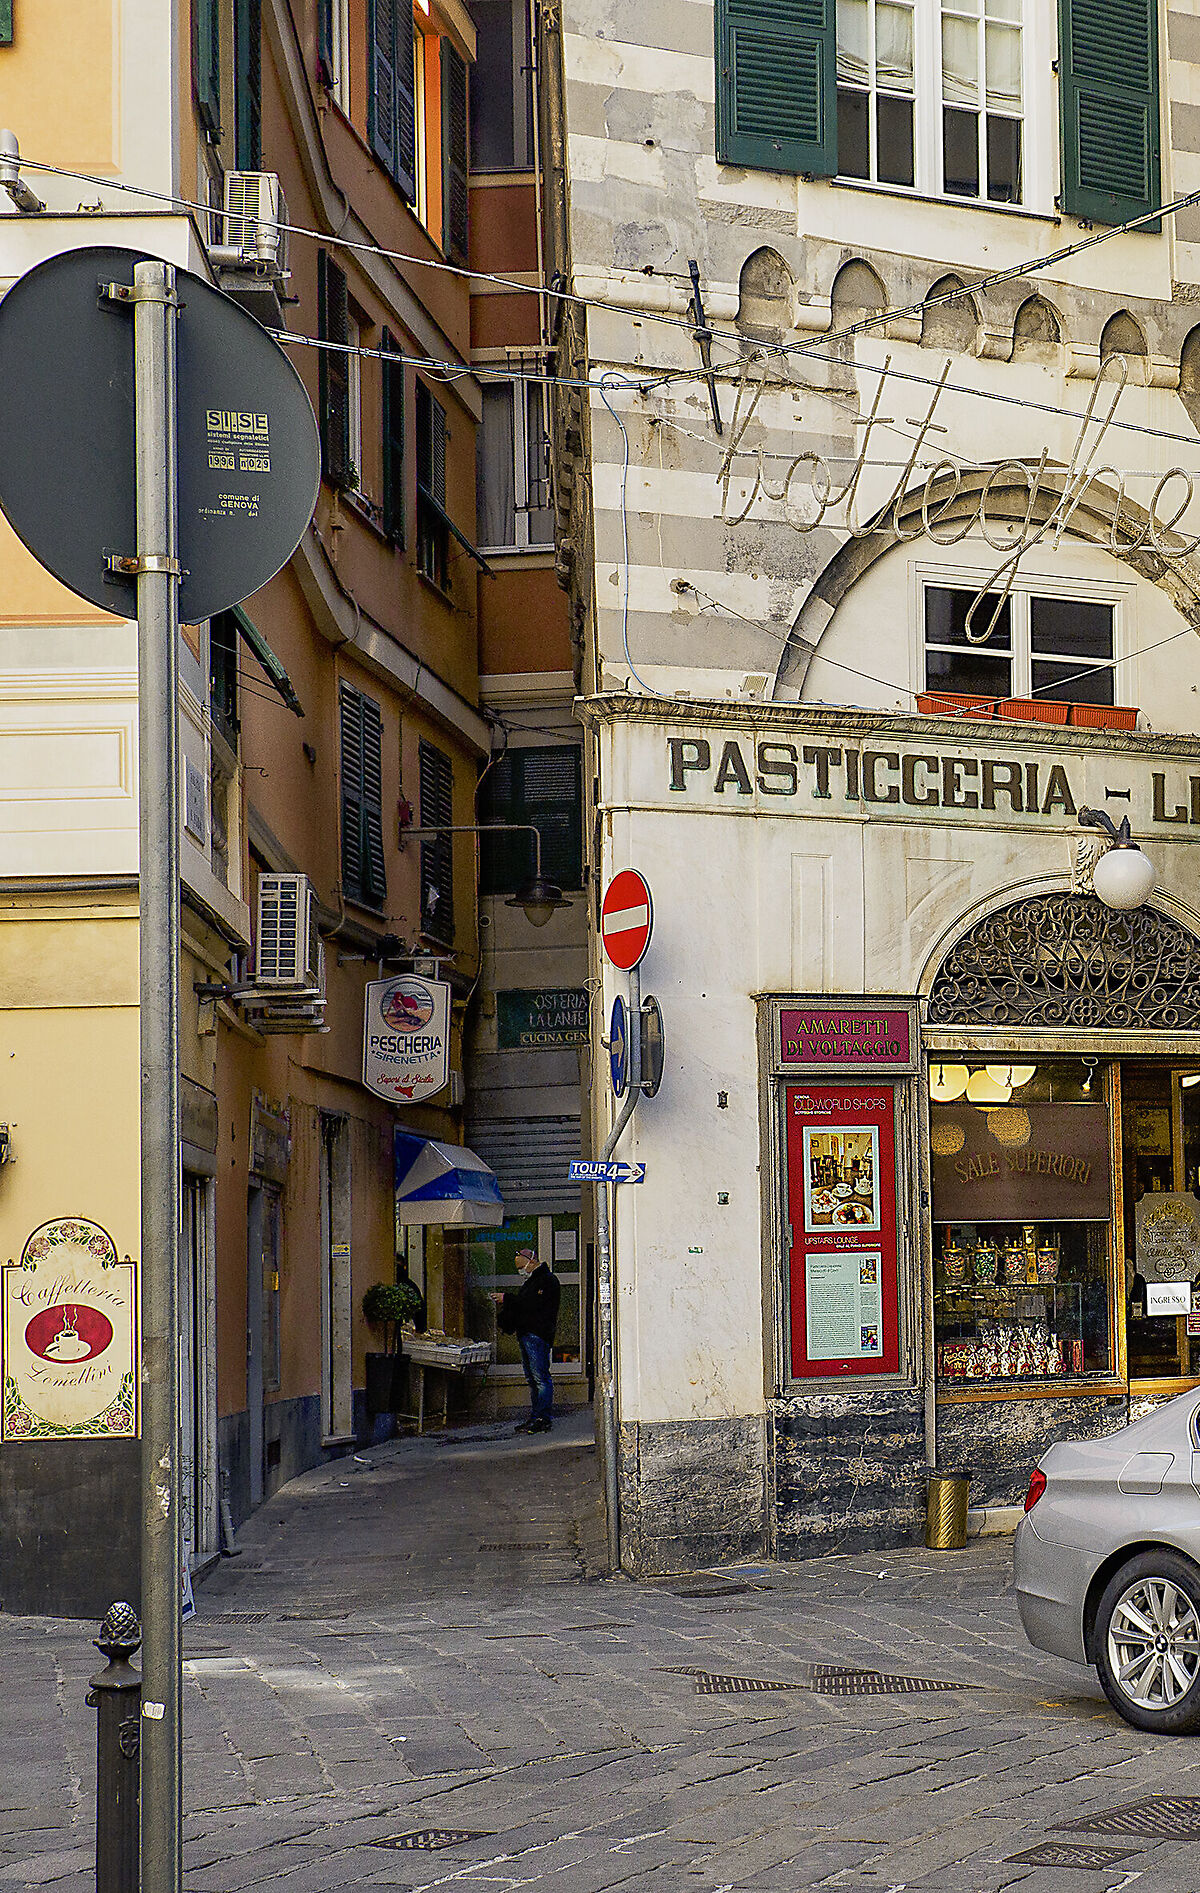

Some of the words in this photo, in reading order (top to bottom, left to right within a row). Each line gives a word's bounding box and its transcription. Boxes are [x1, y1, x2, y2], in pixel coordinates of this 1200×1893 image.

[207, 411, 268, 431] SI.SE
[207, 431, 231, 439] sistemi
[233, 434, 269, 442] segnaletici
[209, 456, 235, 467] 1996
[218, 493, 249, 501] comune
[220, 500, 258, 509] GENOVA
[667, 737, 1077, 816] PASTICCERIA
[534, 993, 587, 1009] OSTERIA
[547, 1011, 588, 1027] LANTE
[797, 1019, 888, 1035] AMARETTI
[370, 1035, 442, 1054] PESCHERIA
[522, 1032, 563, 1043] CUCINA
[787, 1040, 803, 1055] DI
[808, 1040, 901, 1056] VOLTAGGIO
[374, 1051, 438, 1065] SIRENETTA
[852, 1098, 886, 1111] SHOPS
[572, 1162, 607, 1175] TOUR
[606, 1164, 618, 1180] 4
[954, 1152, 1000, 1183] SALE
[1004, 1150, 1091, 1184] SUPERIORI
[834, 1235, 859, 1244] LOUNGE
[12, 1275, 125, 1307] Caffetteria
[1150, 1296, 1186, 1305] INGRESSO
